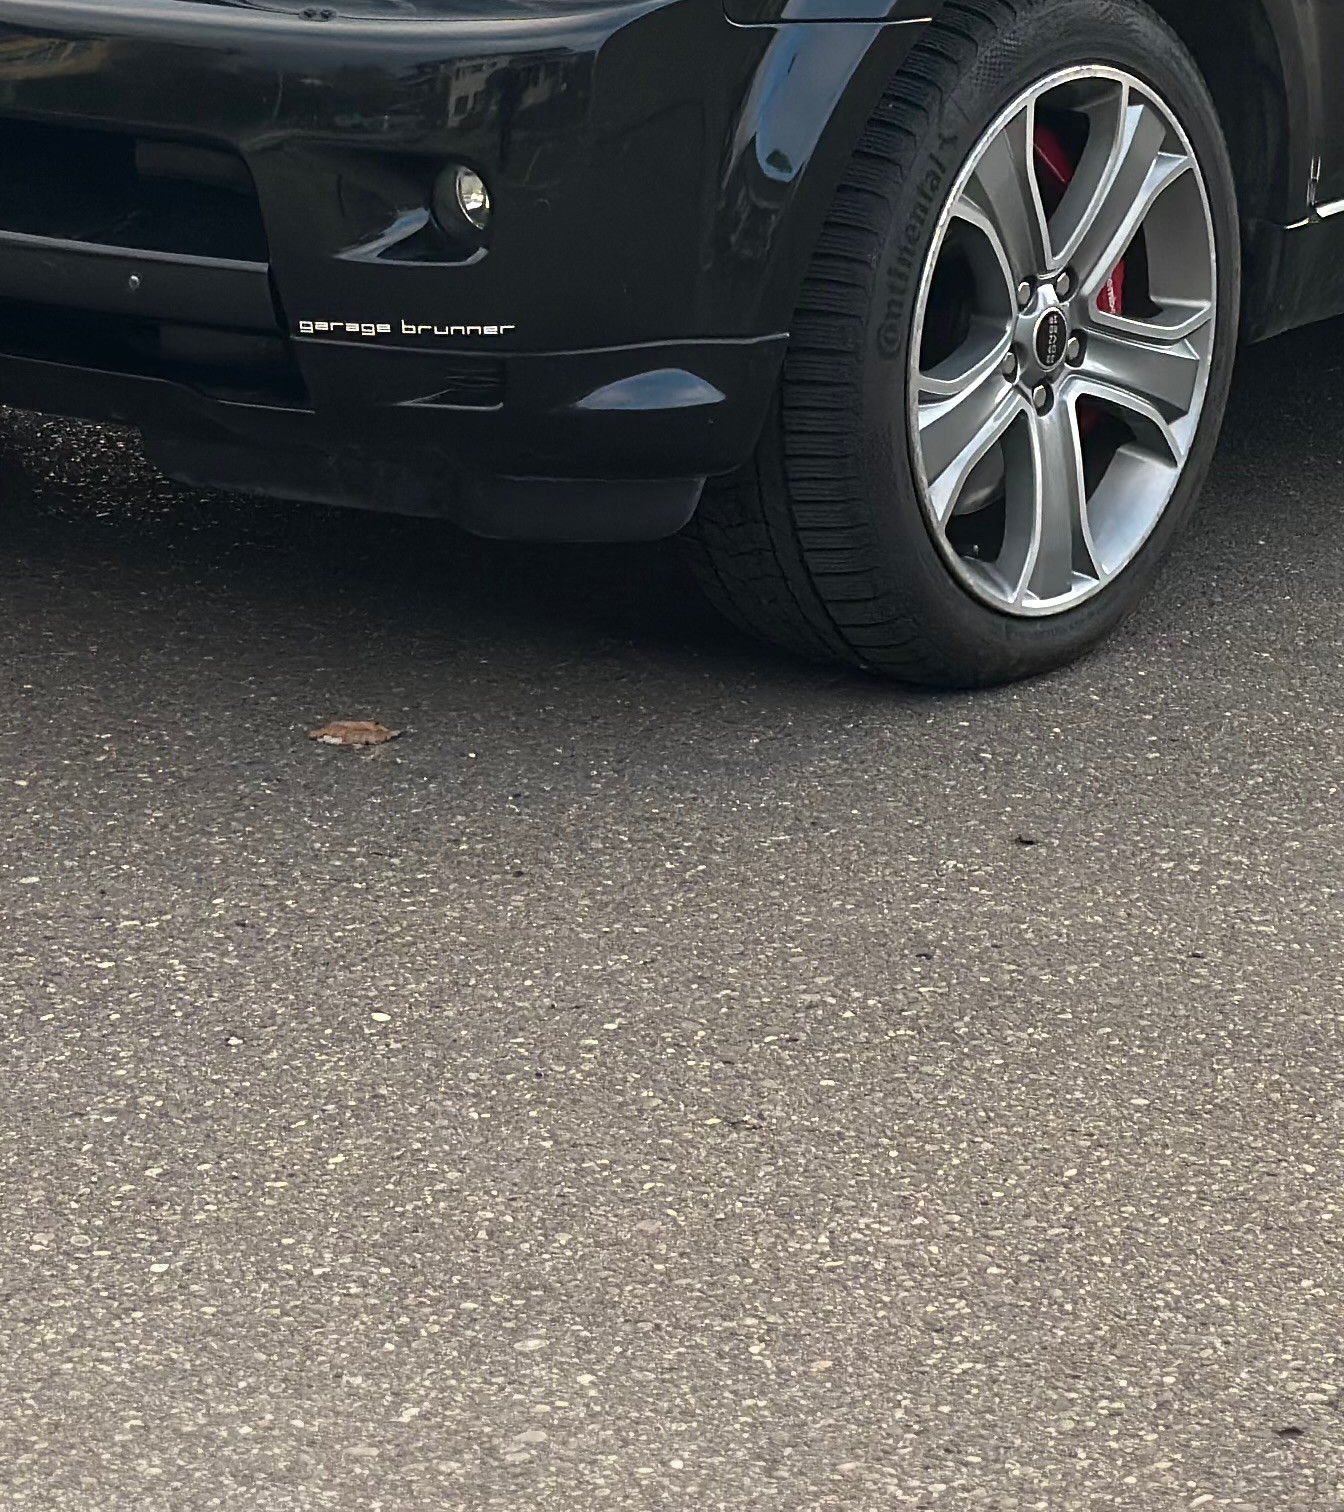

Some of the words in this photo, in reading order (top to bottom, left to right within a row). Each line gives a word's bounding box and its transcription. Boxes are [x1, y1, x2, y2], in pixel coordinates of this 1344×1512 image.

[876, 152, 947, 361] Continental
[298, 319, 392, 337] garage
[400, 319, 516, 336] brunner
